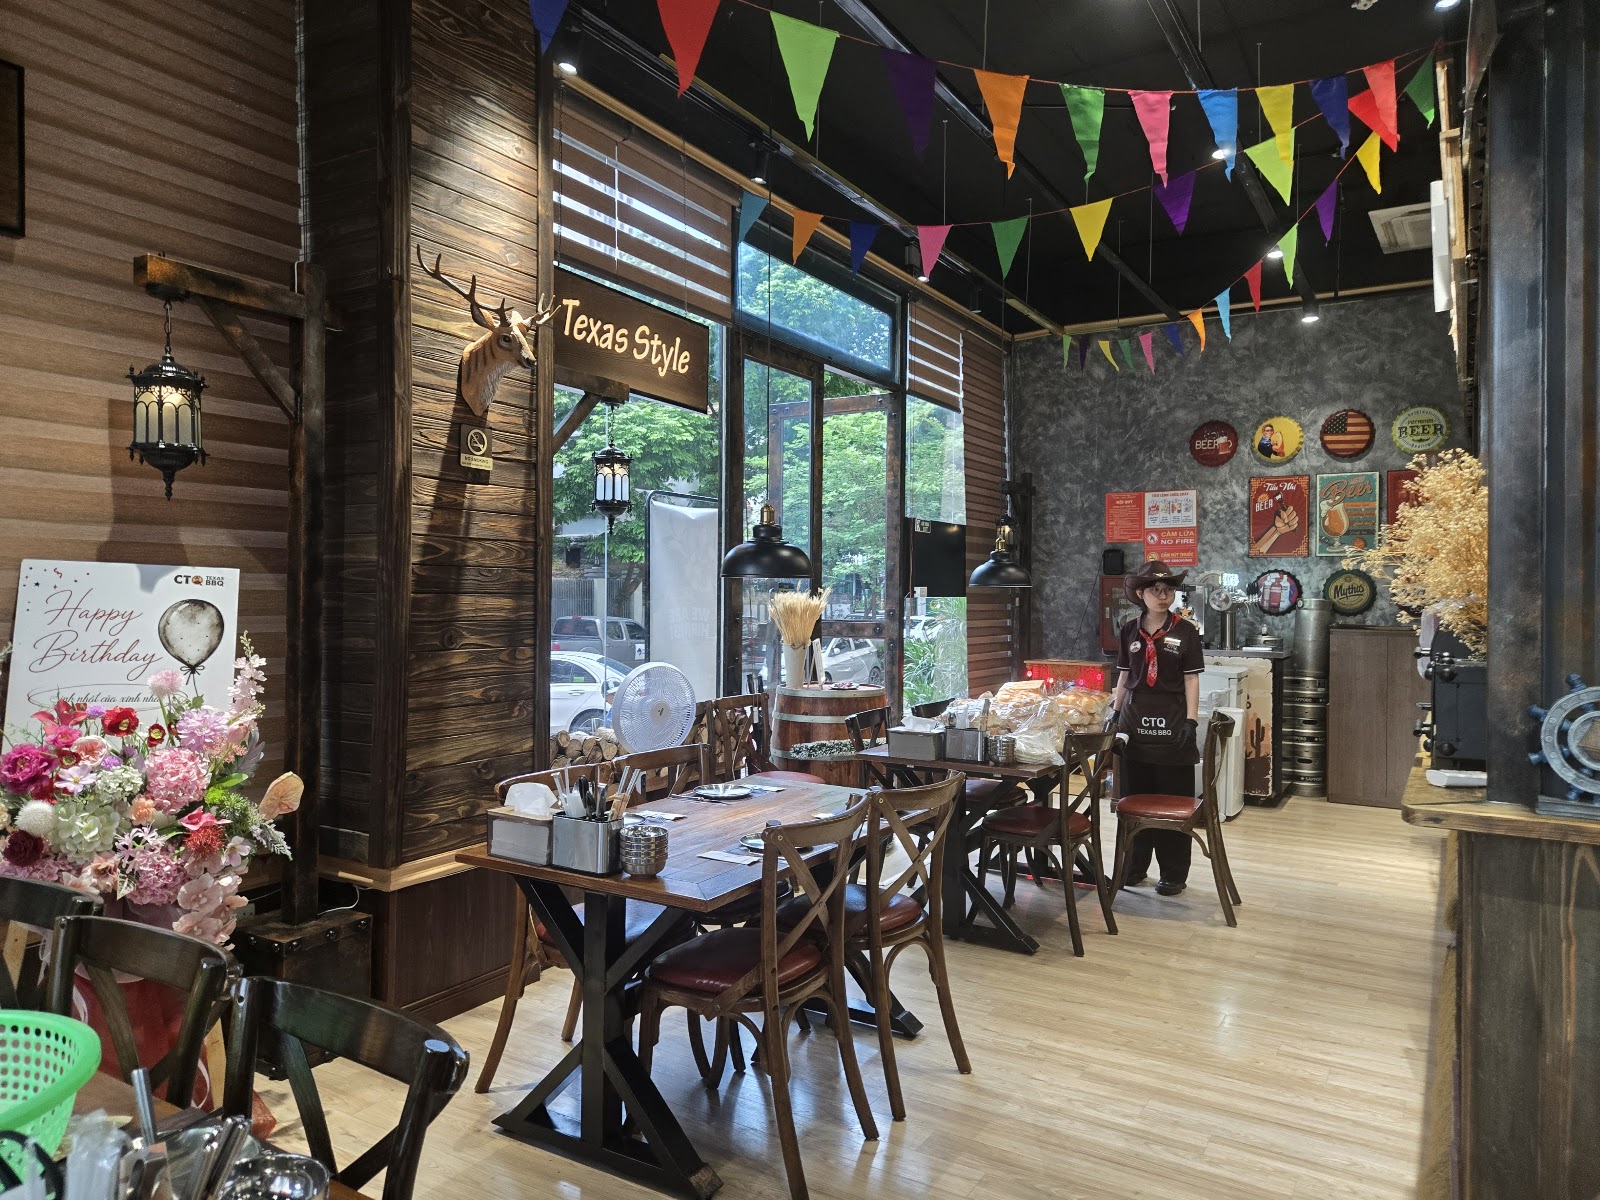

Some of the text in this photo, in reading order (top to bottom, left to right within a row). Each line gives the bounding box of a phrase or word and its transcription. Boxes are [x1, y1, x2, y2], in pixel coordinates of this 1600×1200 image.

[562, 299, 690, 377] Texas Style
[1398, 423, 1444, 439] BEER
[1195, 439, 1219, 449] BEER
[1320, 480, 1372, 507] Beer
[1255, 499, 1273, 512] BEER
[1333, 584, 1364, 600] Mythos
[45, 588, 142, 636] Happy
[29, 630, 163, 681] Birthday
[1142, 717, 1165, 728] CTQ
